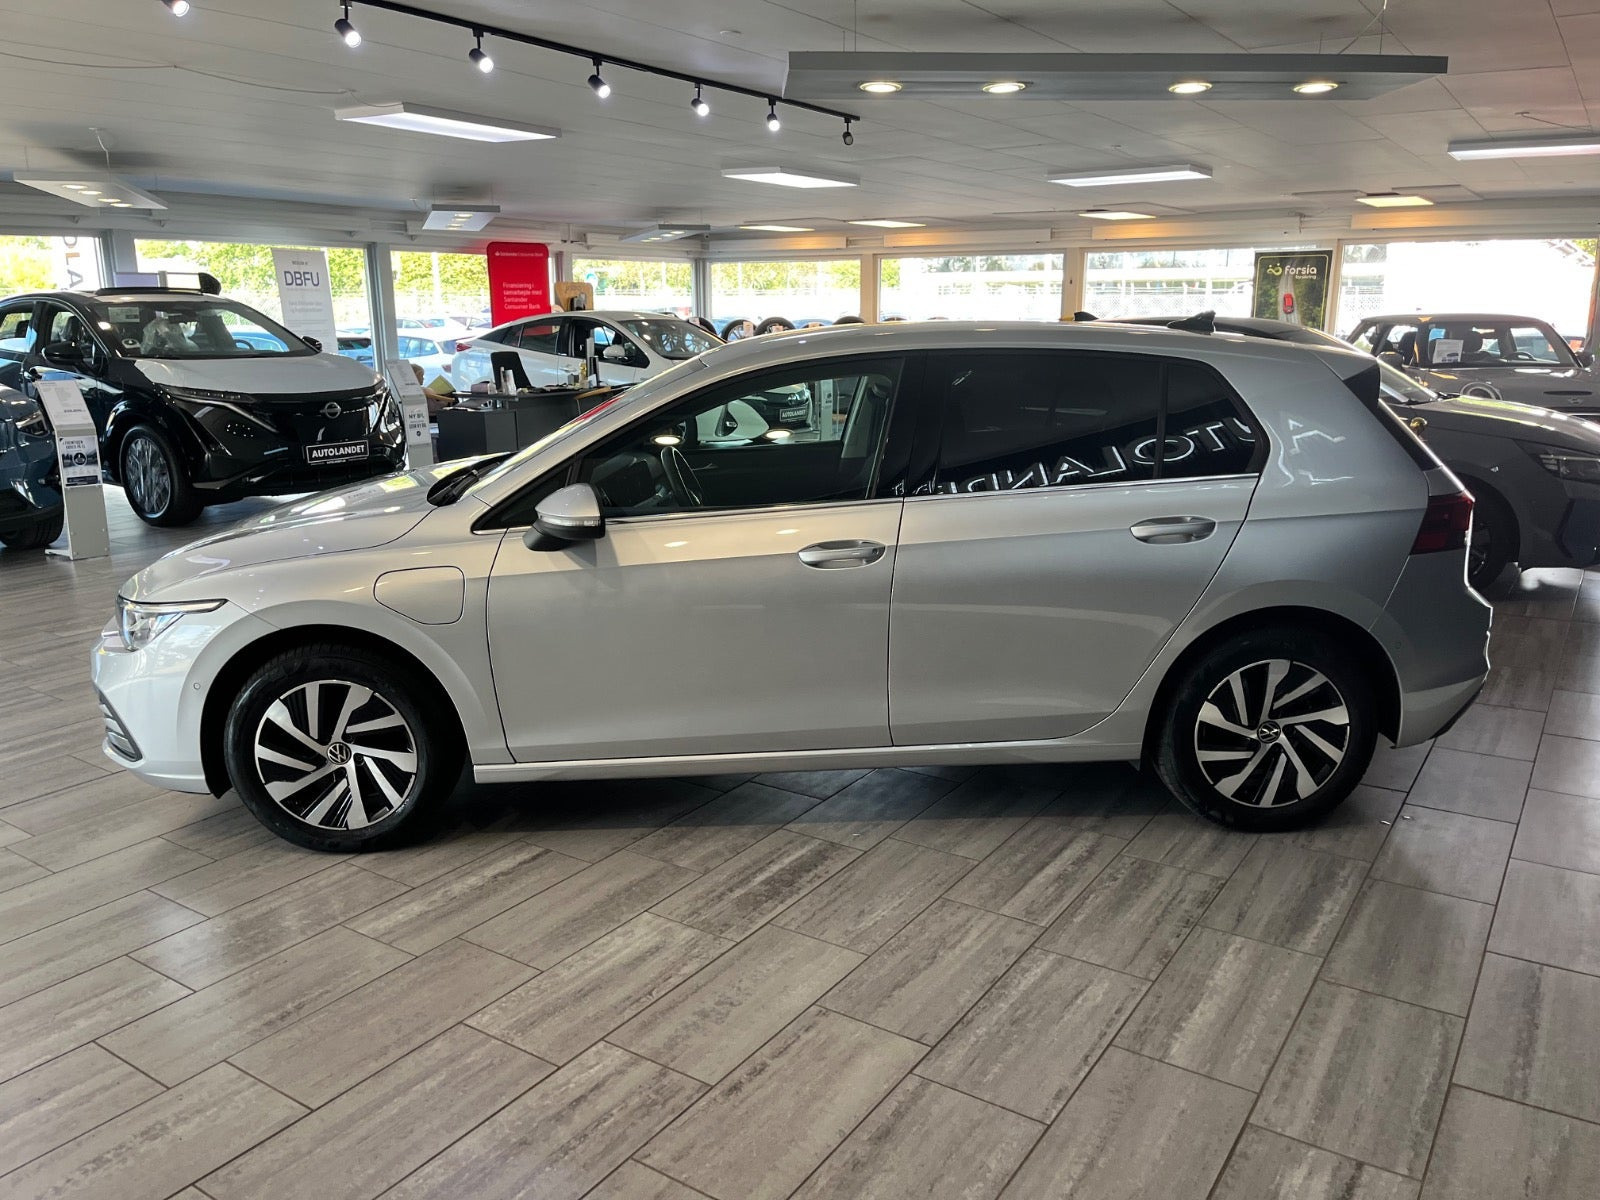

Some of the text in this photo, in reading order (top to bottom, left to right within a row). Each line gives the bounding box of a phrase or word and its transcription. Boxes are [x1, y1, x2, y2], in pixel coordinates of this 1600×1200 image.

[1284, 264, 1317, 275] forsia
[284, 270, 320, 287] DBFU
[311, 445, 365, 458] AUTOLANDET
